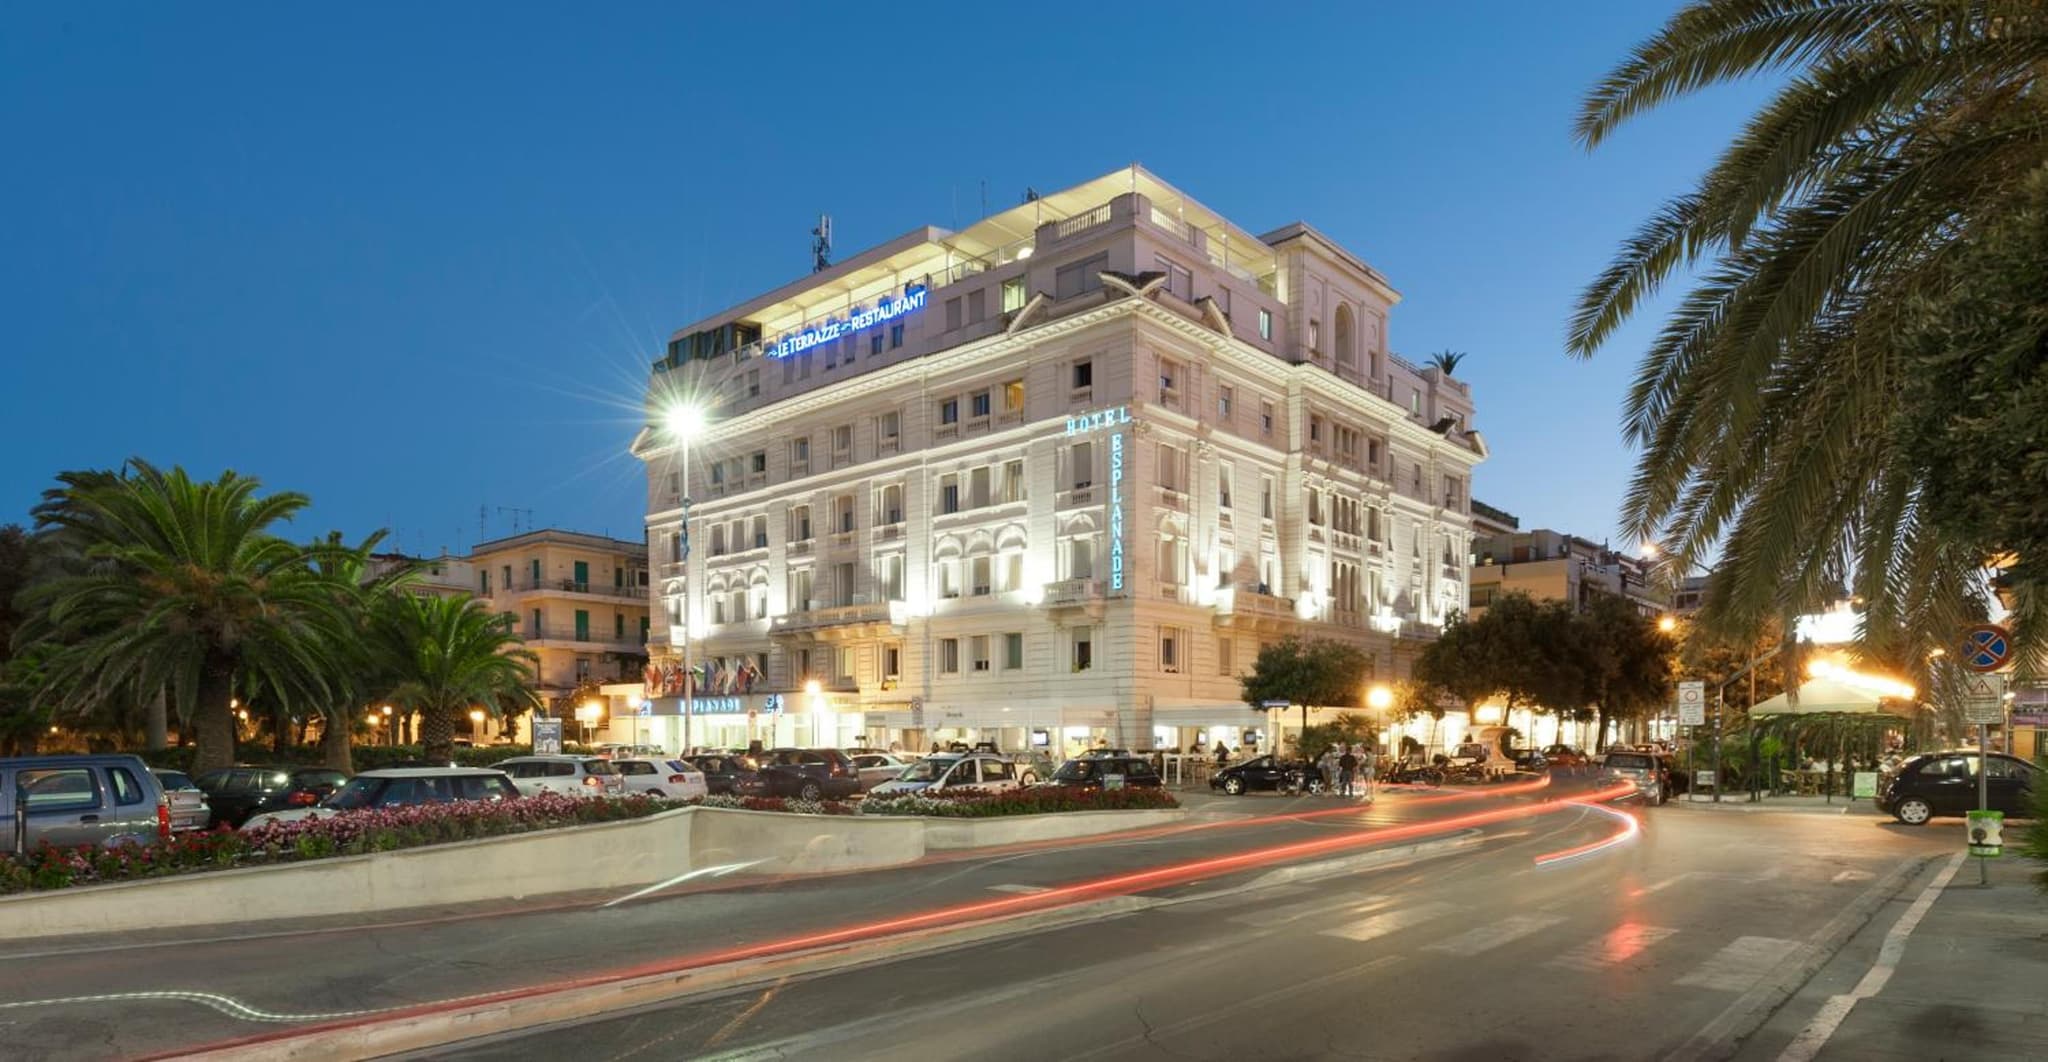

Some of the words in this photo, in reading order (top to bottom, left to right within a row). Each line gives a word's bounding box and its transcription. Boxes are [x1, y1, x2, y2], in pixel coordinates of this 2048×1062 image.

[778, 342, 789, 358] LE
[788, 324, 841, 353] TERRAZZE
[852, 291, 926, 331] RESTAURANT
[1067, 406, 1132, 436] HOTEL
[1111, 434, 1123, 589] ESPLANADE
[680, 698, 741, 713] EPLANADE
